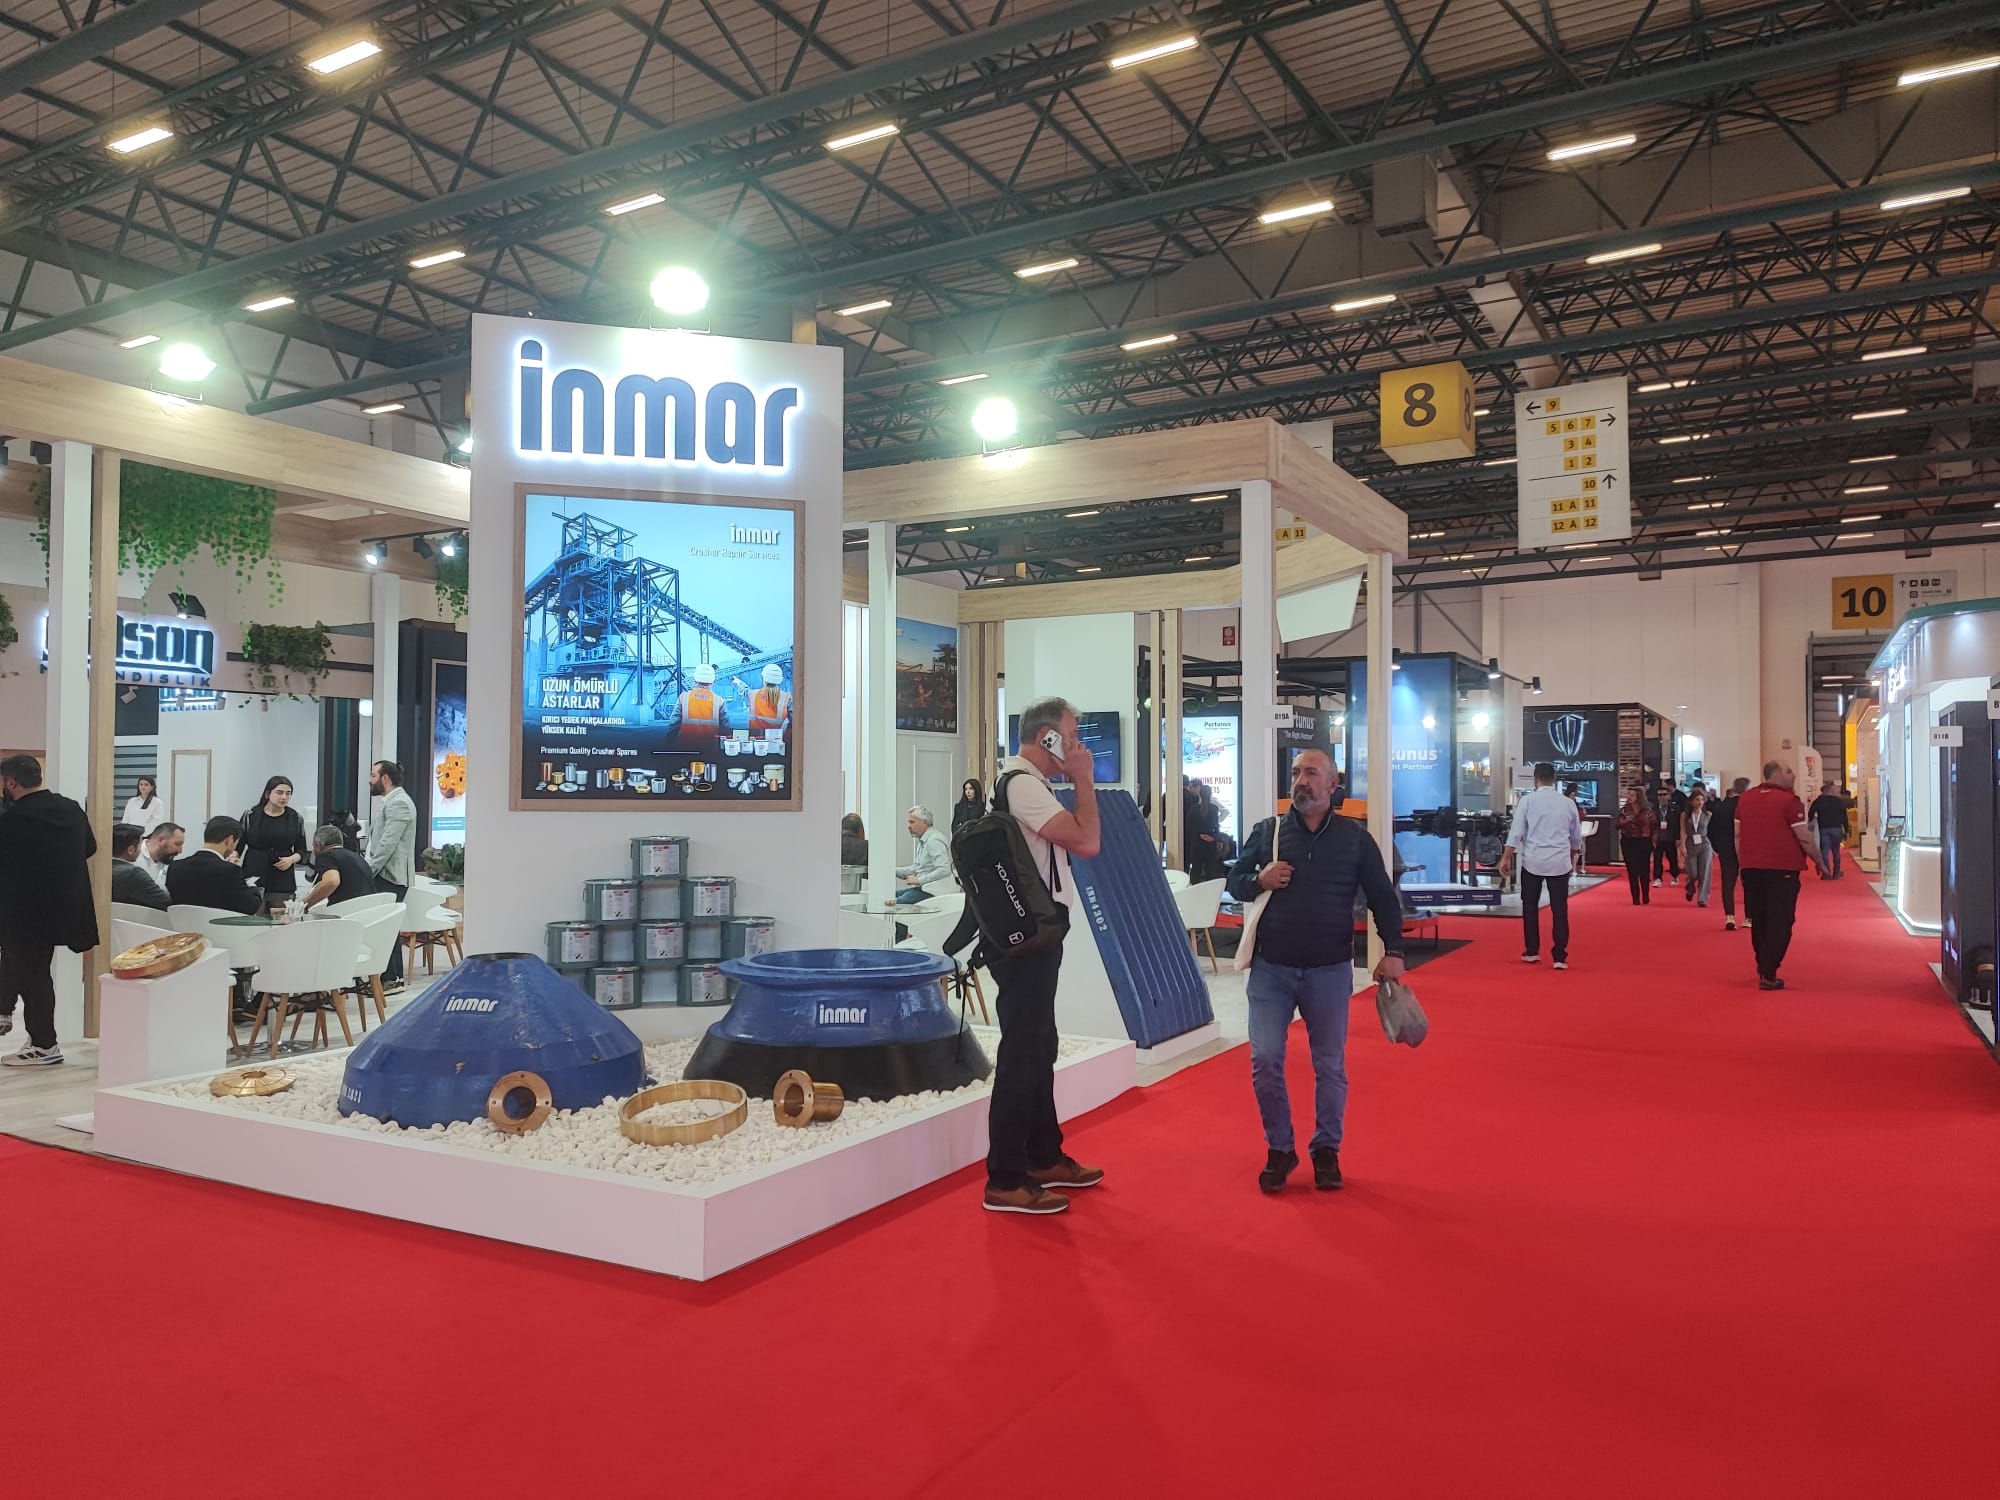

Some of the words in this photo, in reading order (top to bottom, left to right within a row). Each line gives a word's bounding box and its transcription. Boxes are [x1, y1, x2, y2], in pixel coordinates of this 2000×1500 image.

[520, 340, 797, 466] inmar
[1403, 383, 1437, 427] 8
[1463, 387, 1471, 432] 8
[1549, 400, 1557, 410] 9
[1550, 423, 1557, 433] 5
[1567, 421, 1574, 430] 6
[1585, 418, 1591, 428] 7
[1568, 439, 1575, 449] 3
[1585, 437, 1592, 446] 4
[1568, 458, 1575, 468] 1
[1586, 456, 1592, 466] 2
[1584, 479, 1596, 489] 10
[1552, 502, 1564, 512] 11
[1569, 500, 1577, 510] A
[1585, 498, 1595, 508] 11
[1553, 521, 1565, 531] 12
[1569, 519, 1577, 529] A
[1585, 517, 1597, 527] 12
[730, 522, 780, 546] inmar
[1282, 530, 1289, 538] A
[1295, 529, 1304, 538] 11
[1840, 586, 1887, 617] 10
[542, 679, 570, 693] UZUN
[573, 676, 619, 694] ÖMÜRLÜ
[542, 694, 600, 709] ASTARLAR
[541, 725, 564, 734] YÜKSEK
[540, 746, 569, 754] Premium
[569, 746, 591, 757] Quality
[592, 747, 615, 755] Crusher
[616, 748, 638, 757] Spares
[994, 862, 1026, 918] ORTOVOX
[445, 996, 498, 1012] inmar
[819, 1003, 868, 1025] inmar
